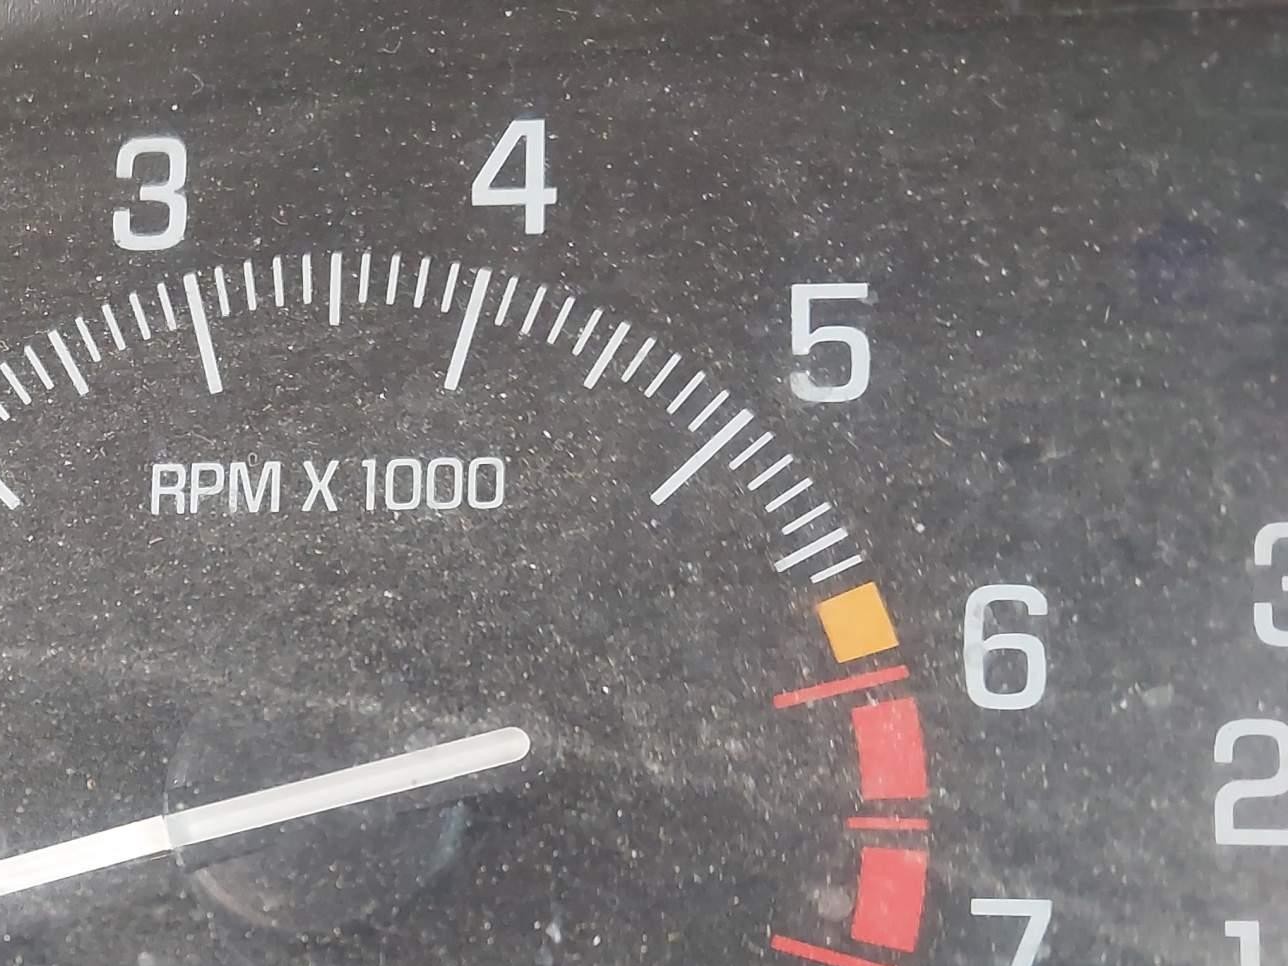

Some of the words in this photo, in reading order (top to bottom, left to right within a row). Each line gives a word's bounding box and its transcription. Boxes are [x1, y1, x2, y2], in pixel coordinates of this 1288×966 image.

[113, 136, 189, 252] 3
[471, 119, 558, 235] 4
[789, 282, 872, 403] 5
[150, 461, 281, 516] RPM
[302, 460, 338, 513] X
[362, 457, 506, 512] 1000
[963, 584, 1048, 710] 6
